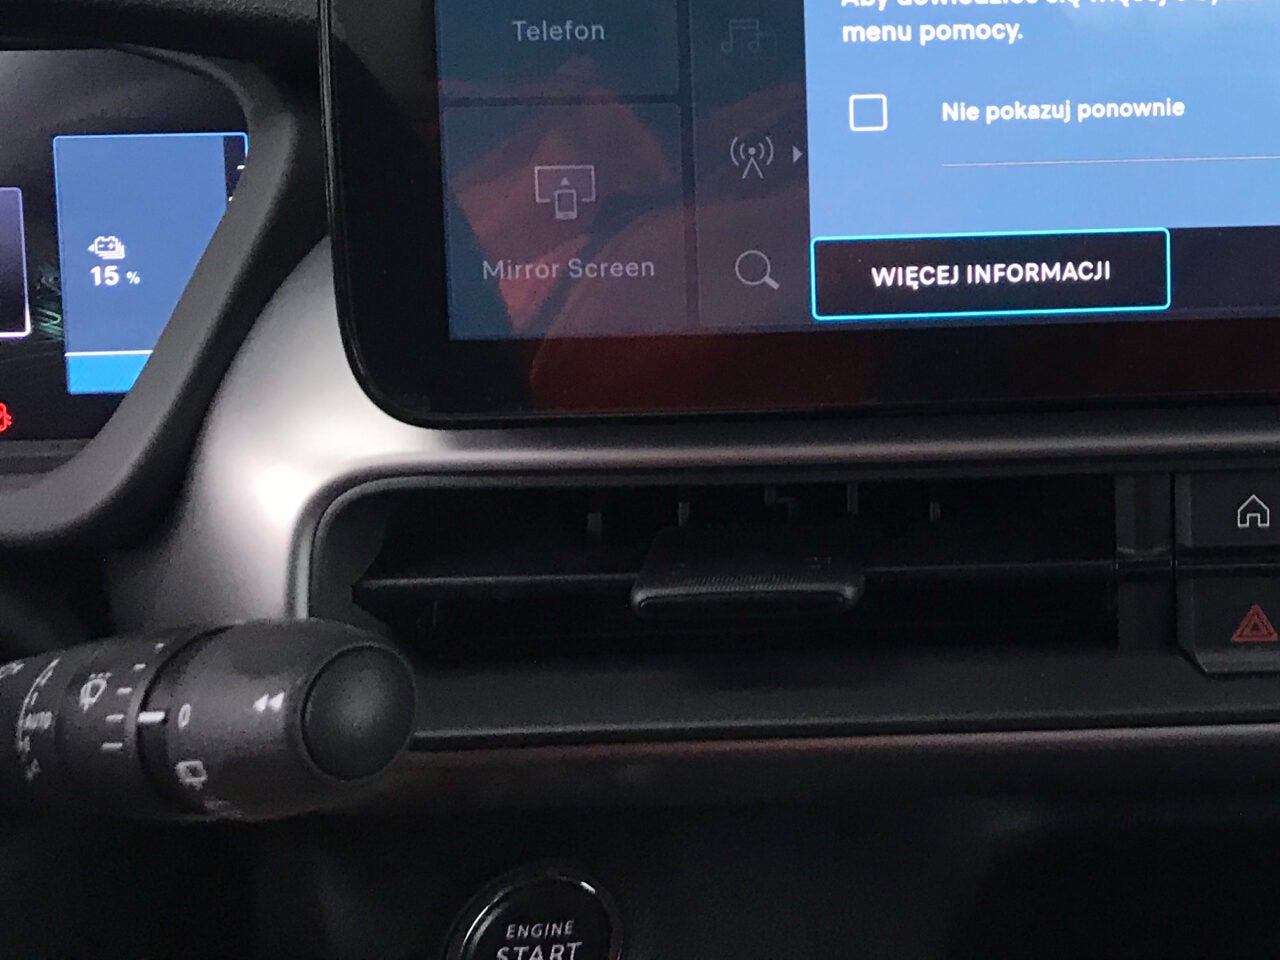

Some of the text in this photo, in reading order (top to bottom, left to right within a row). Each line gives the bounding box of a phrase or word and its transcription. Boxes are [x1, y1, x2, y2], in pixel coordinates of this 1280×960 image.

[511, 19, 606, 42] Telefon
[842, 22, 1024, 46] menu pomocy.
[941, 97, 1186, 124] Nie pokazuj ponownie
[90, 266, 141, 286] 15 %
[482, 257, 656, 280] Mirror Screen
[871, 260, 1112, 290] WIĘCEJ INFORMACJI
[506, 920, 574, 940] ENGINE
[496, 942, 583, 960] START
